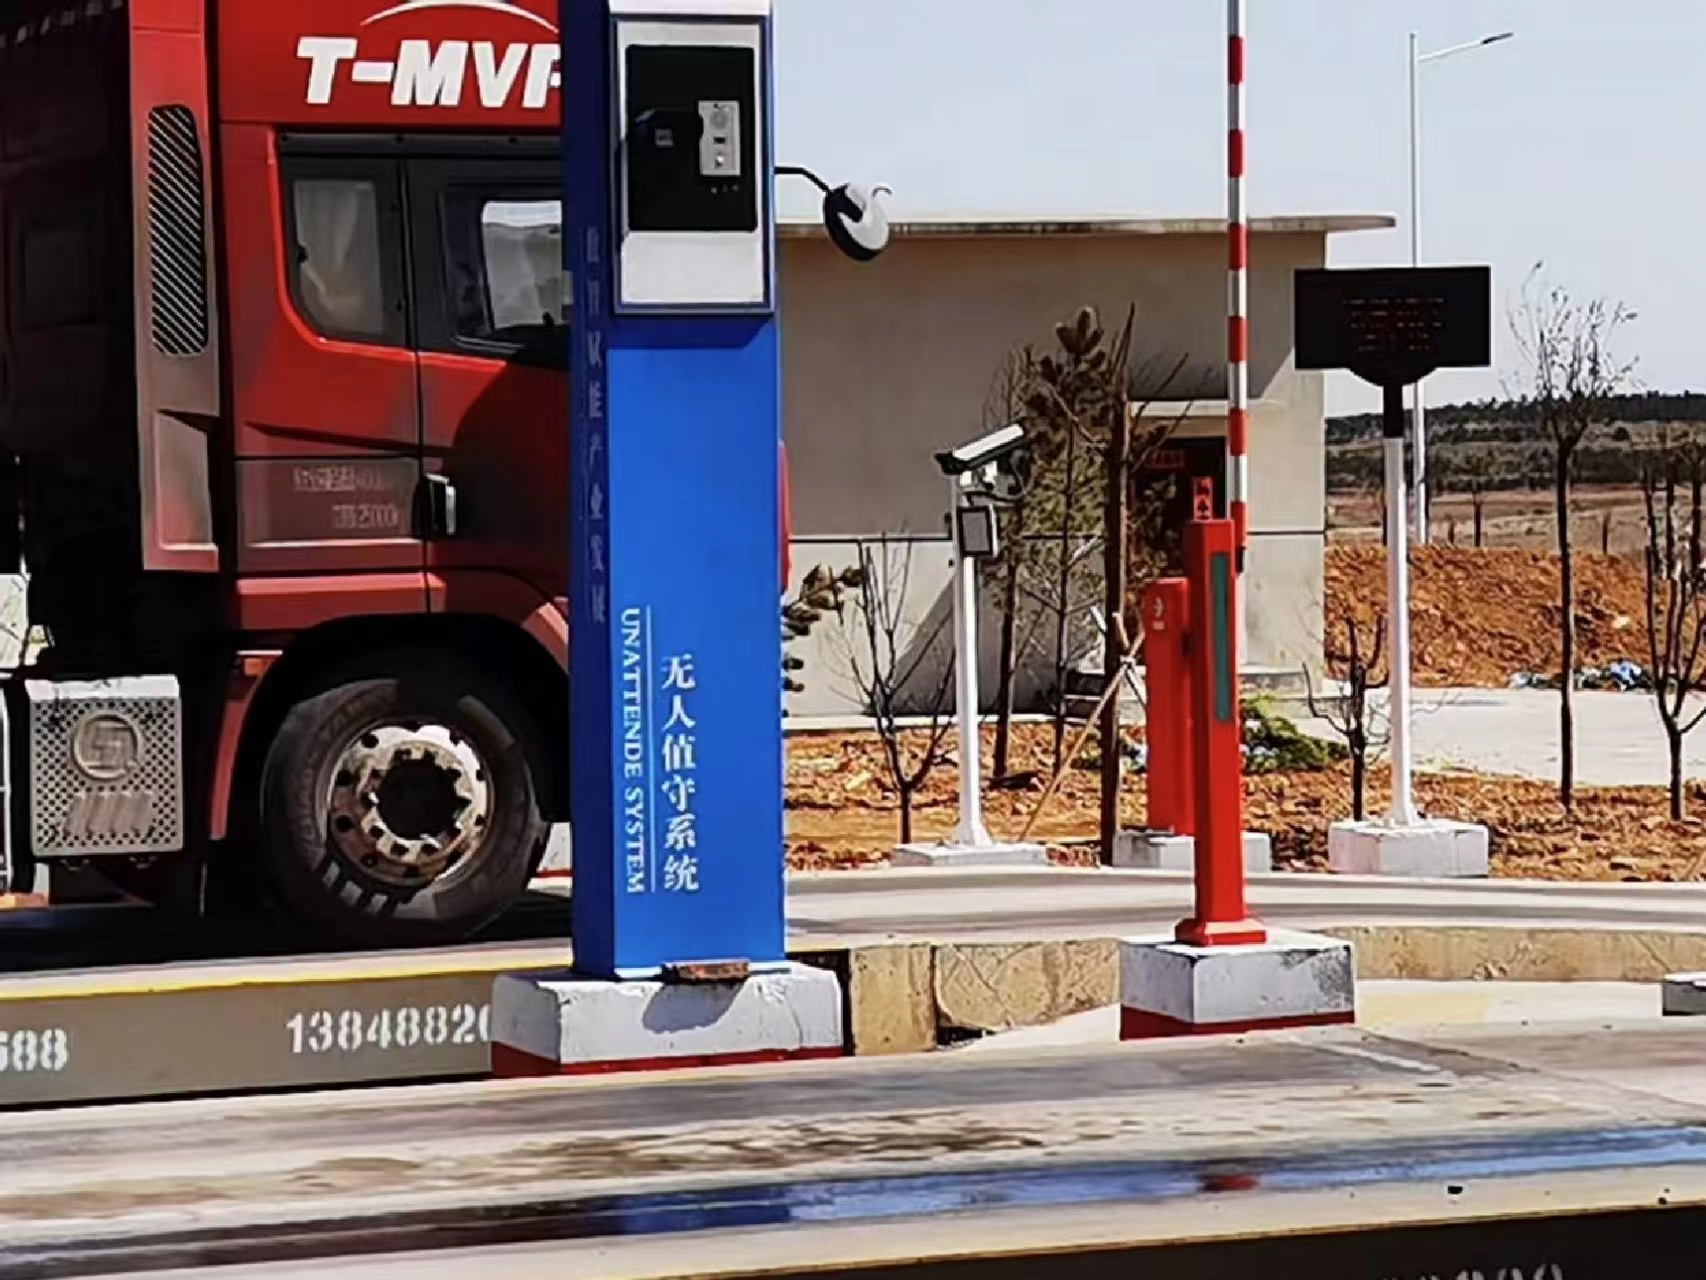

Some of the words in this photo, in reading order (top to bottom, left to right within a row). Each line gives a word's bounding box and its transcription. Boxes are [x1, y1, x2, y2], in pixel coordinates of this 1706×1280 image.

[621, 608, 643, 779] UNATTENDE
[660, 653, 699, 892] 无人值守系统
[624, 787, 645, 893] SYSTEM
